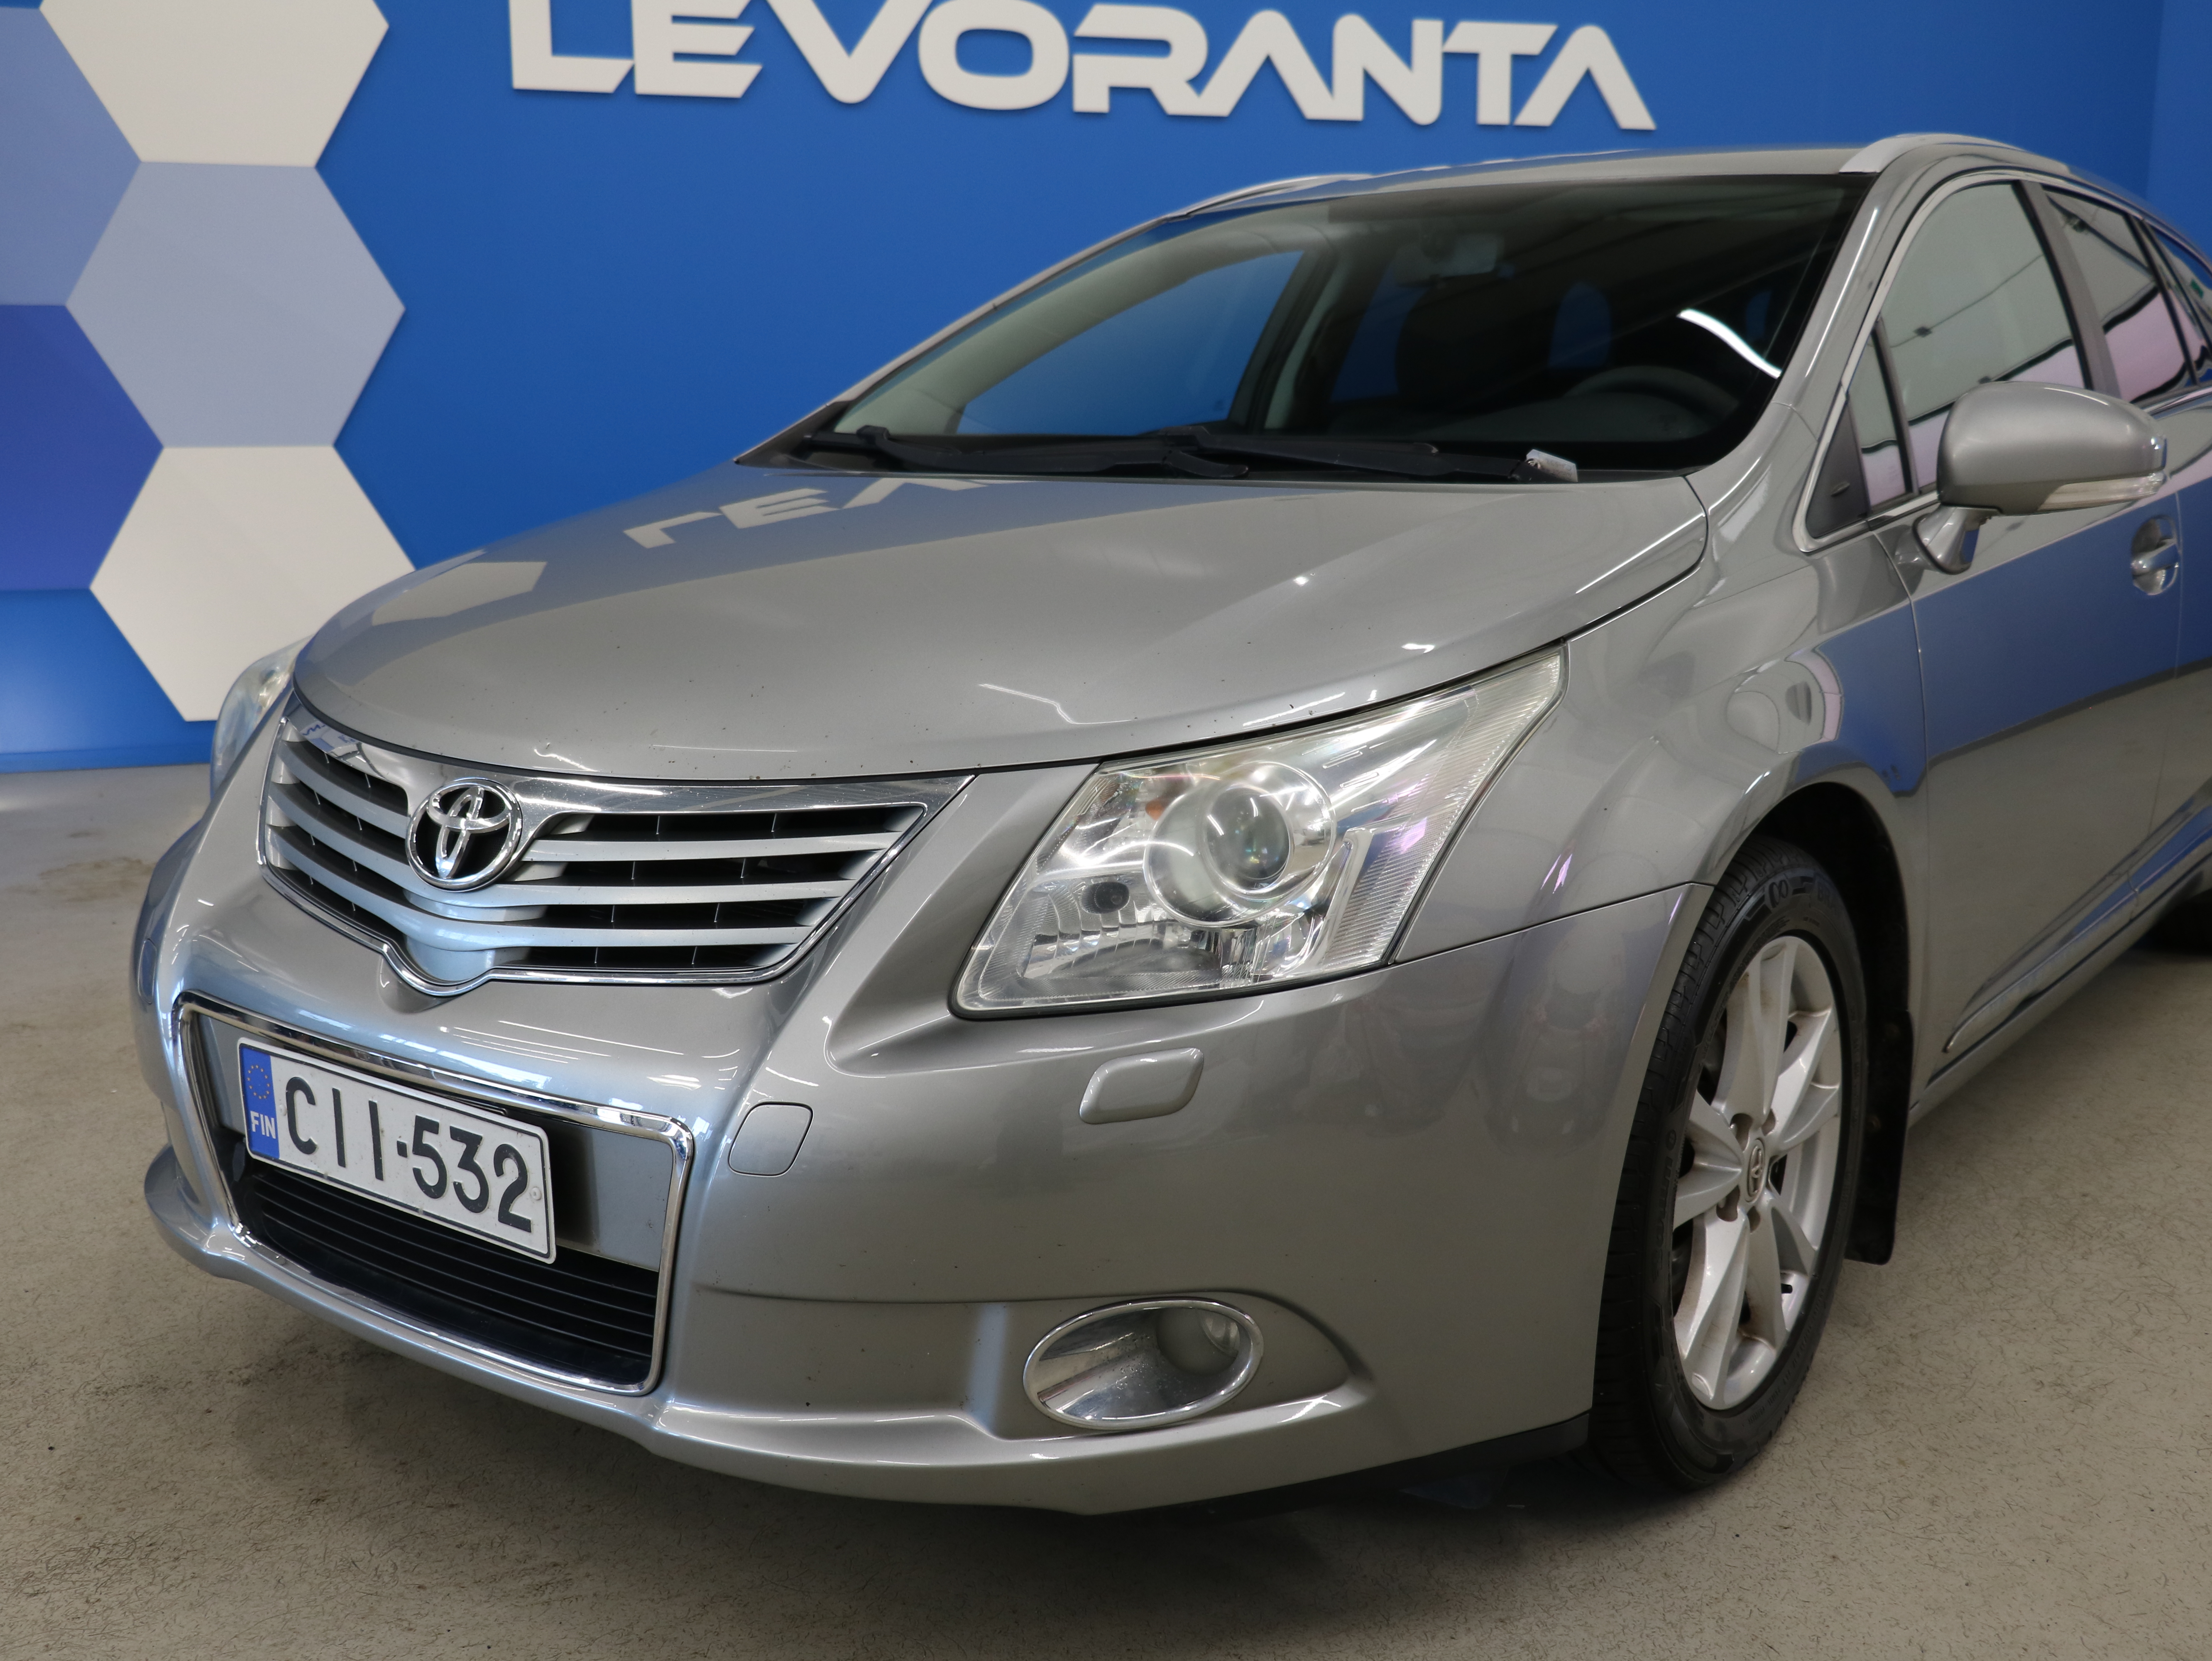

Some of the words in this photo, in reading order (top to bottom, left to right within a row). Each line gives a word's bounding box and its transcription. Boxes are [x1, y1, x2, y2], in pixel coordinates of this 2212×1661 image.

[512, 0, 1656, 131] LEVORANTA
[250, 1110, 276, 1139] FIN
[285, 1076, 532, 1233] CII-532
